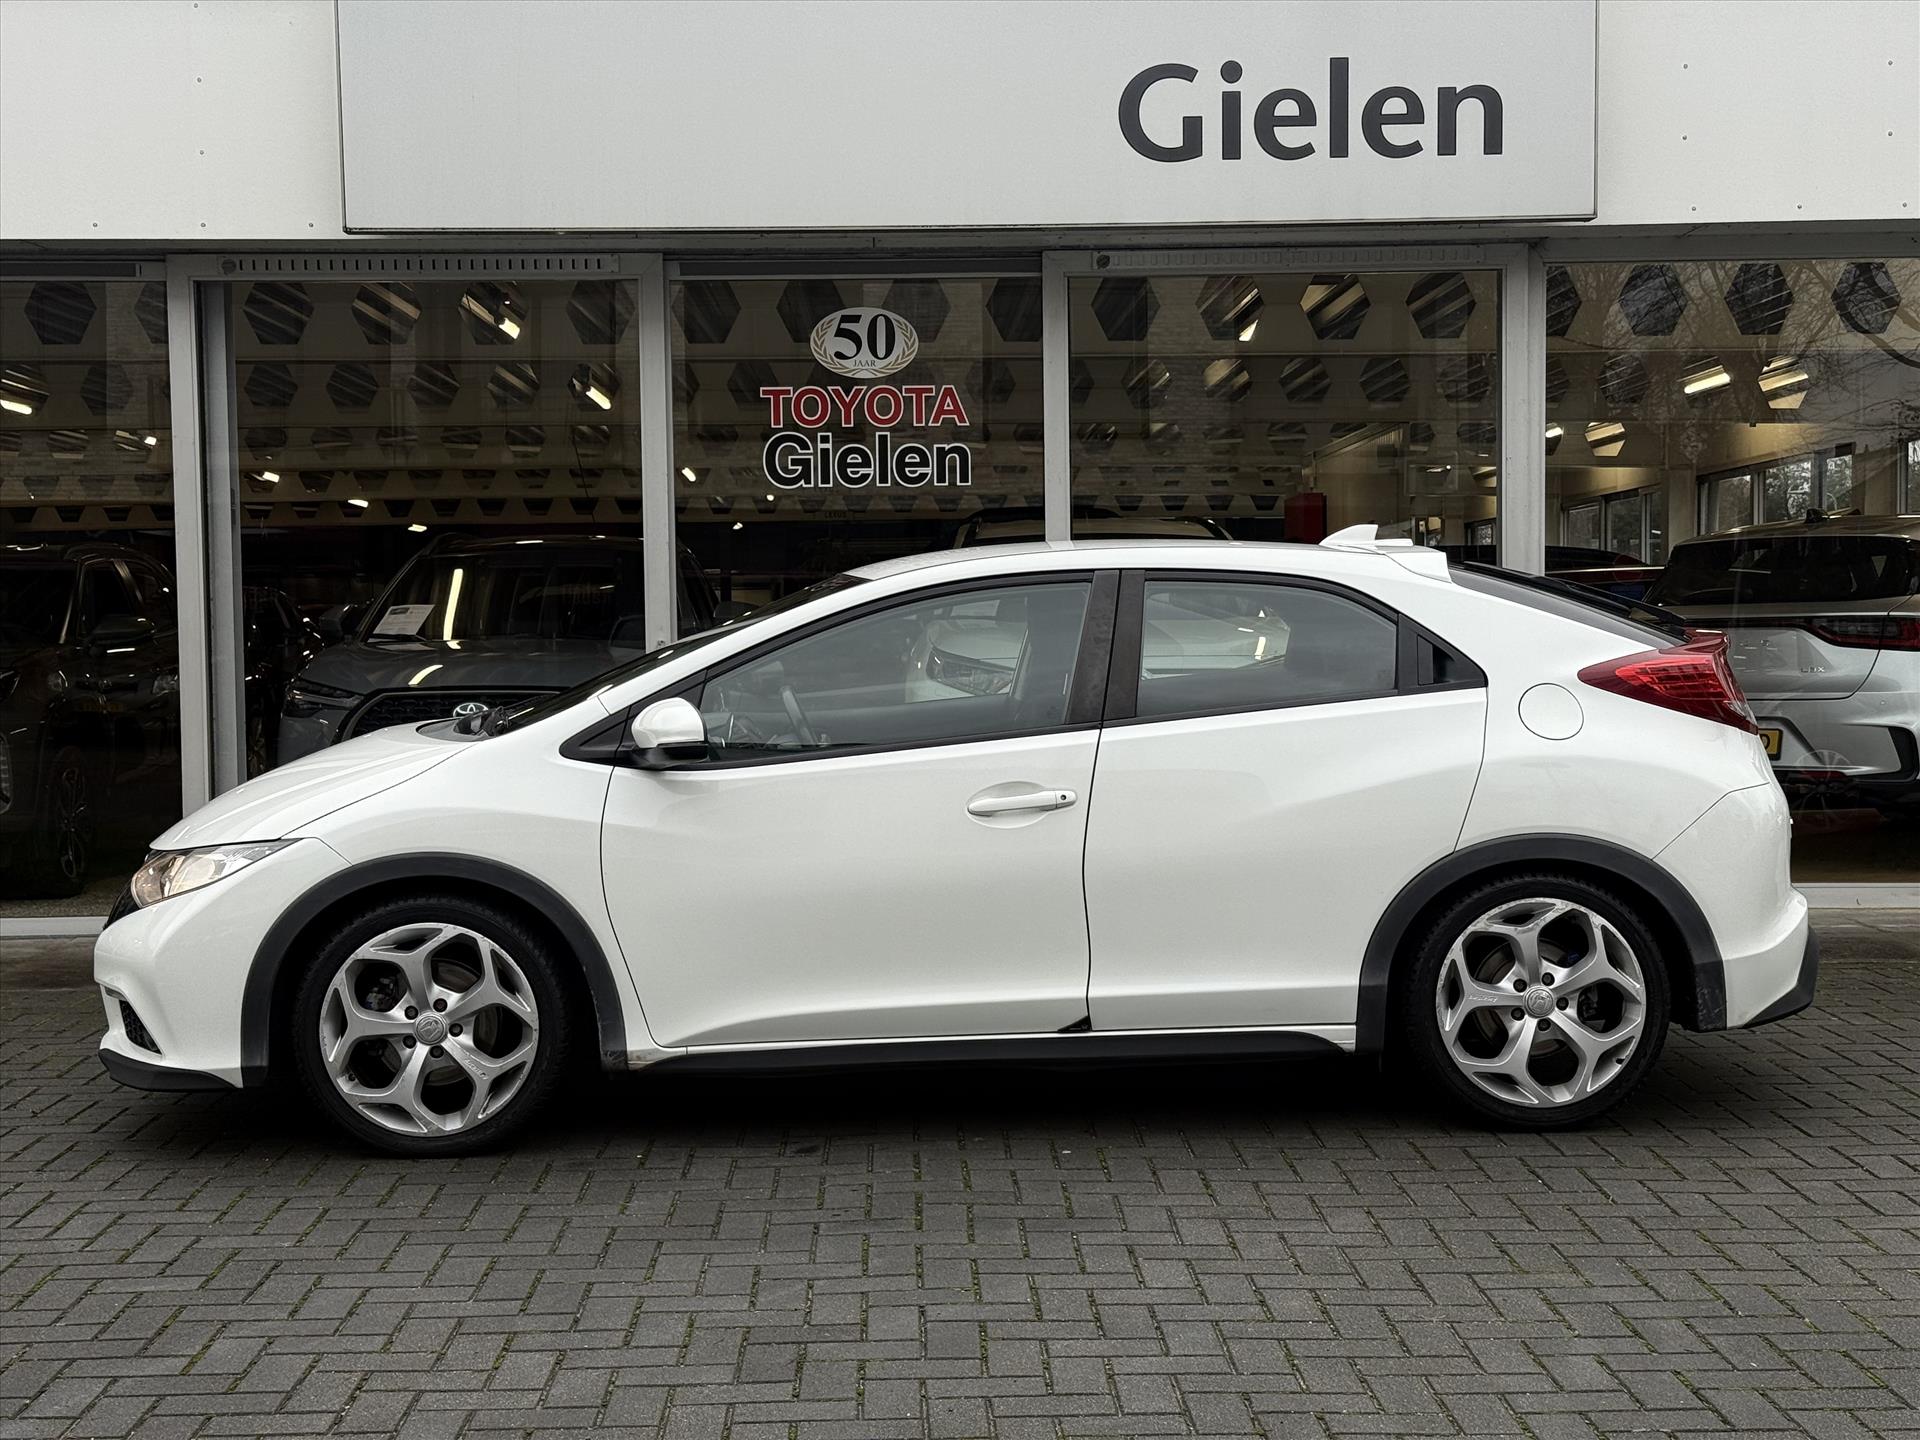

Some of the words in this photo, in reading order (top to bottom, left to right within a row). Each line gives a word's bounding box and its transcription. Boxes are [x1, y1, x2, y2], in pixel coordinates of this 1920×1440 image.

[1118, 57, 1503, 163] Gielen
[833, 314, 896, 360] 50
[852, 359, 877, 368] JAAR
[760, 385, 970, 428] TOYOTA
[763, 431, 972, 489] Gielen
